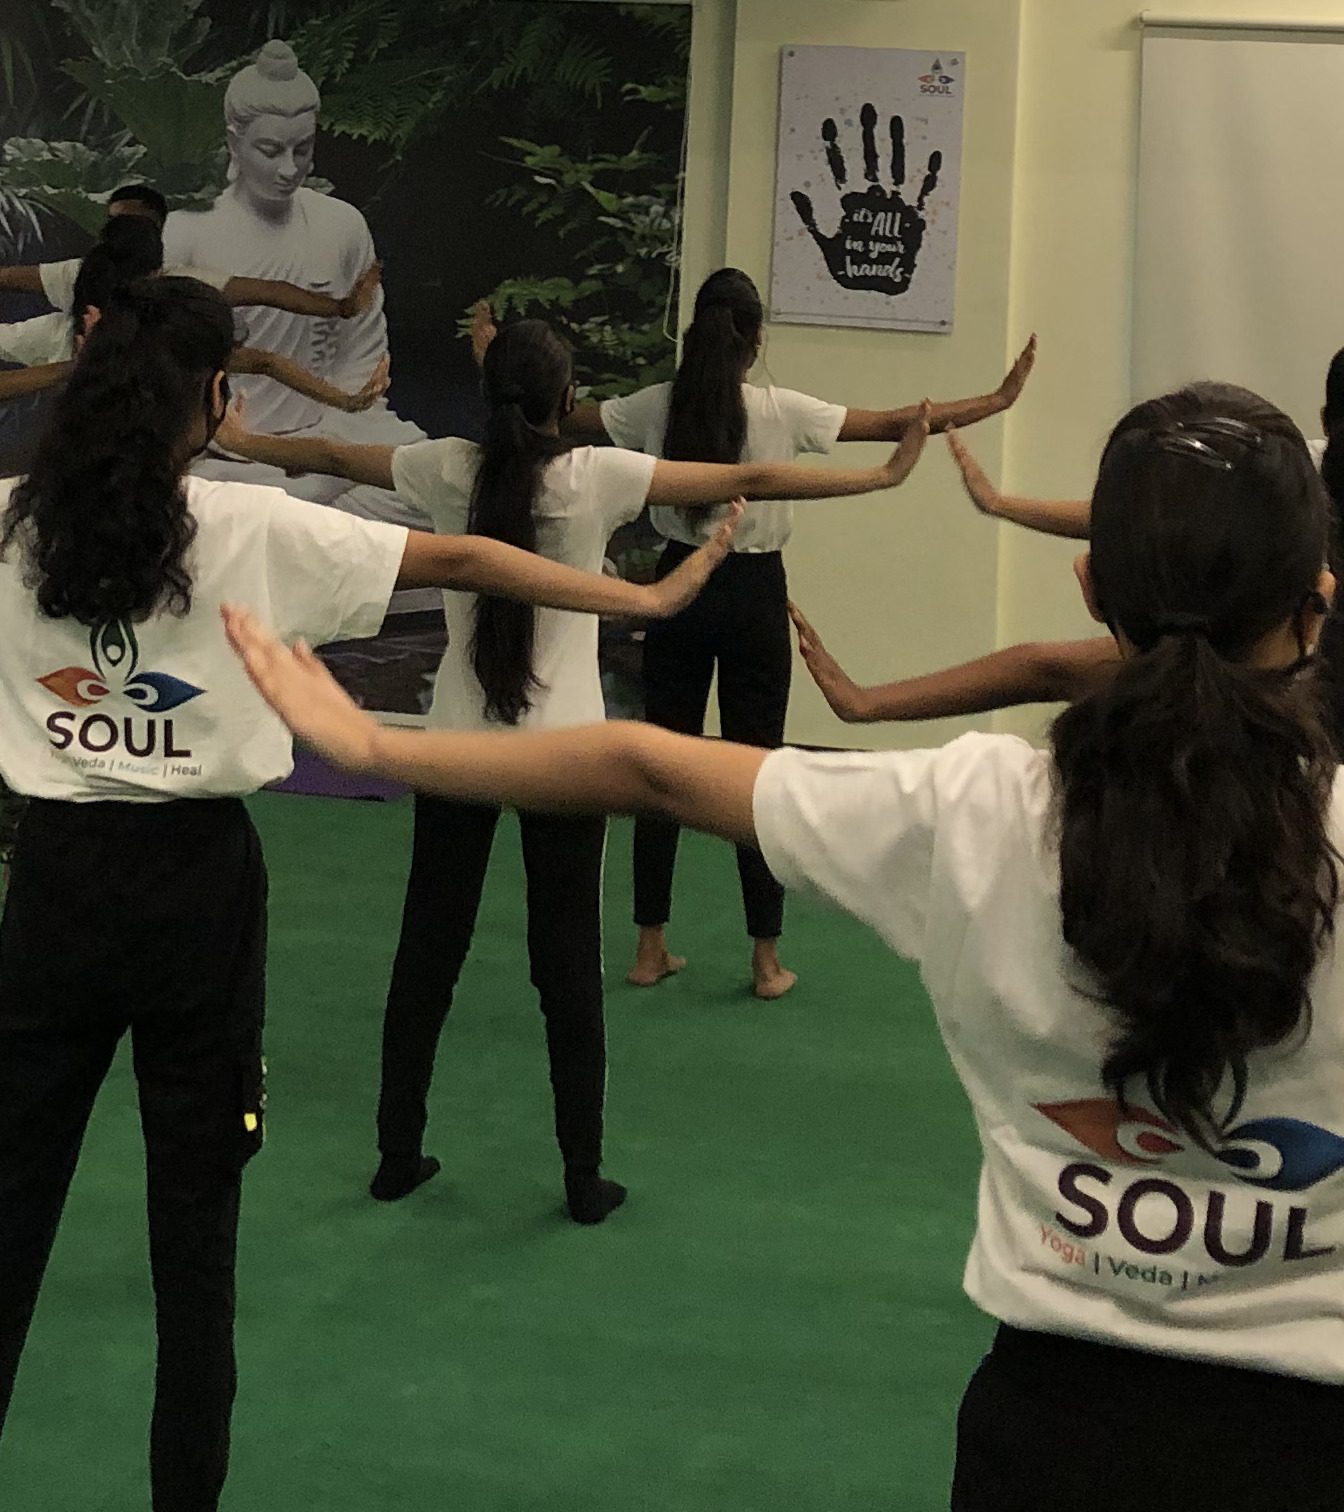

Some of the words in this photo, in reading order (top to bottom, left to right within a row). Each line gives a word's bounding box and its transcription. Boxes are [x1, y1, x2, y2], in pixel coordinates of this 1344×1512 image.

[920, 84, 952, 94] SOUL
[870, 211, 902, 237] ALL
[845, 235, 864, 252] in
[868, 240, 905, 259] your
[46, 710, 192, 758] SOUL
[72, 756, 105, 769] Veda
[171, 764, 202, 776] Heal
[1056, 1162, 1336, 1268] SOUL
[1041, 1222, 1086, 1266] Yoga
[1108, 1255, 1173, 1286] Veda
